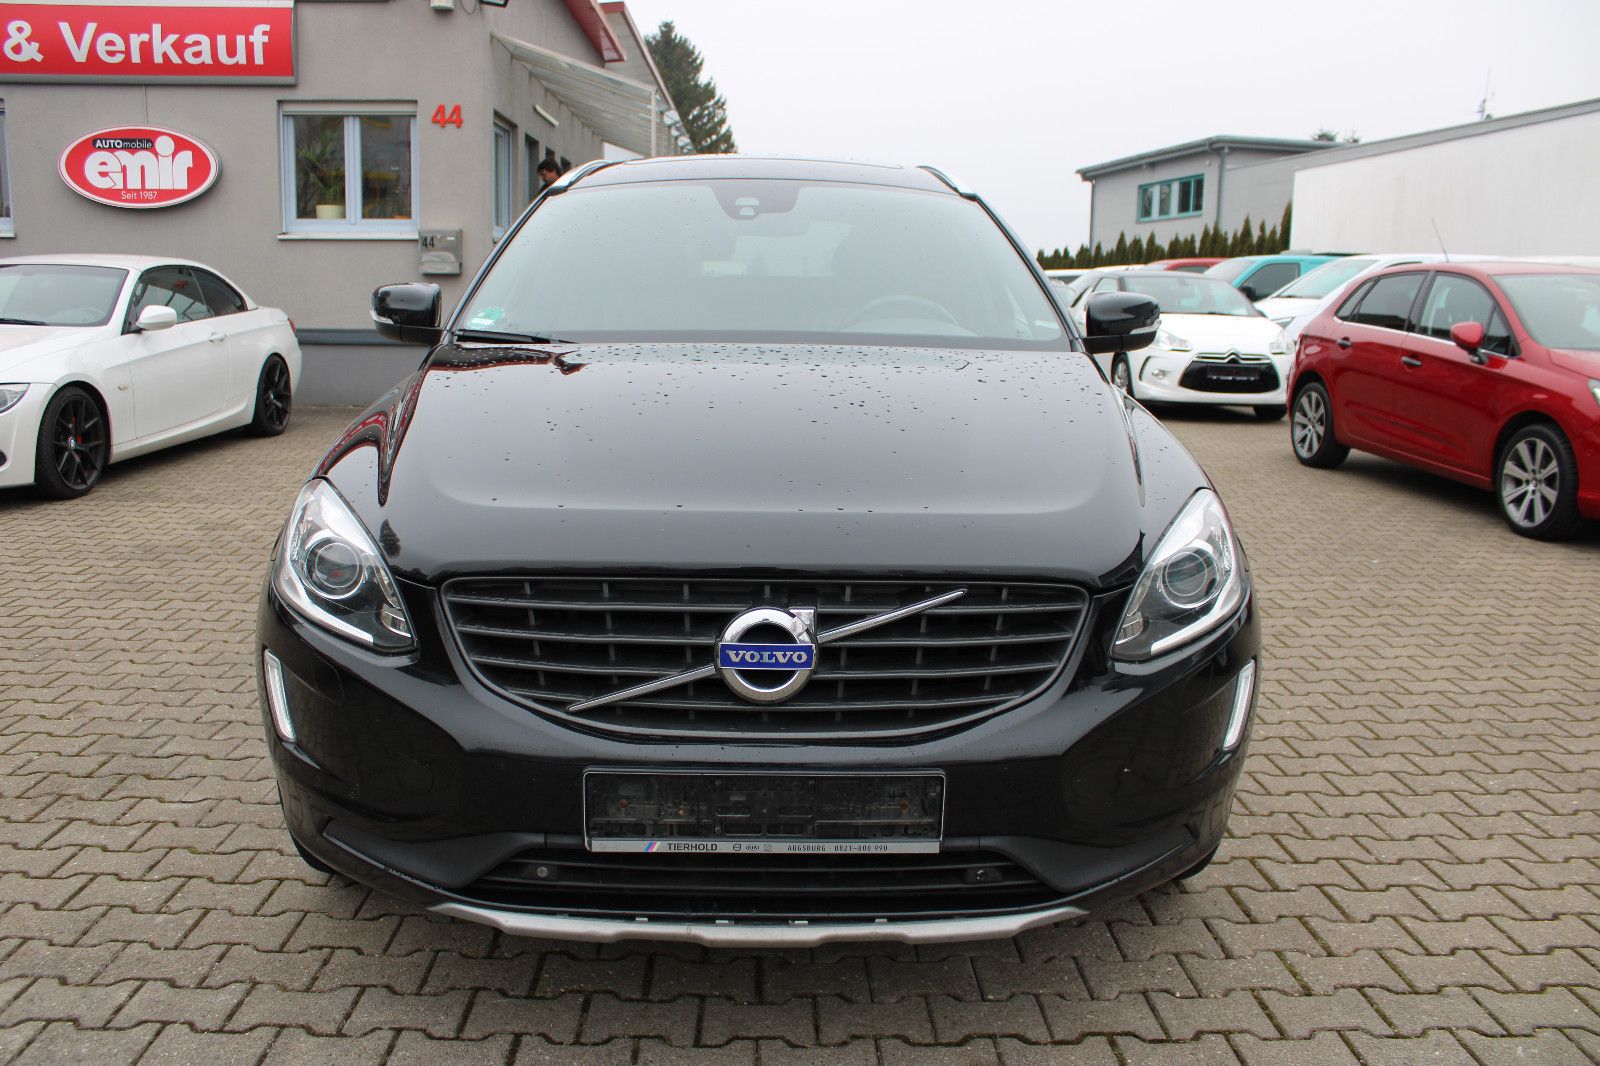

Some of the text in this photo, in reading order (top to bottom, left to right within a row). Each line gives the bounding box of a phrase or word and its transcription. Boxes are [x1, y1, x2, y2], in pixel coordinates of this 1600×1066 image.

[3, 21, 270, 65] & Verkauf
[431, 104, 463, 129] 44
[96, 139, 153, 149] AUTOmobile
[85, 135, 193, 190] emir
[121, 191, 158, 200] Seit 1987
[421, 236, 435, 248] 44
[725, 650, 808, 663] VOLVO
[667, 842, 718, 852] TIERHOLD
